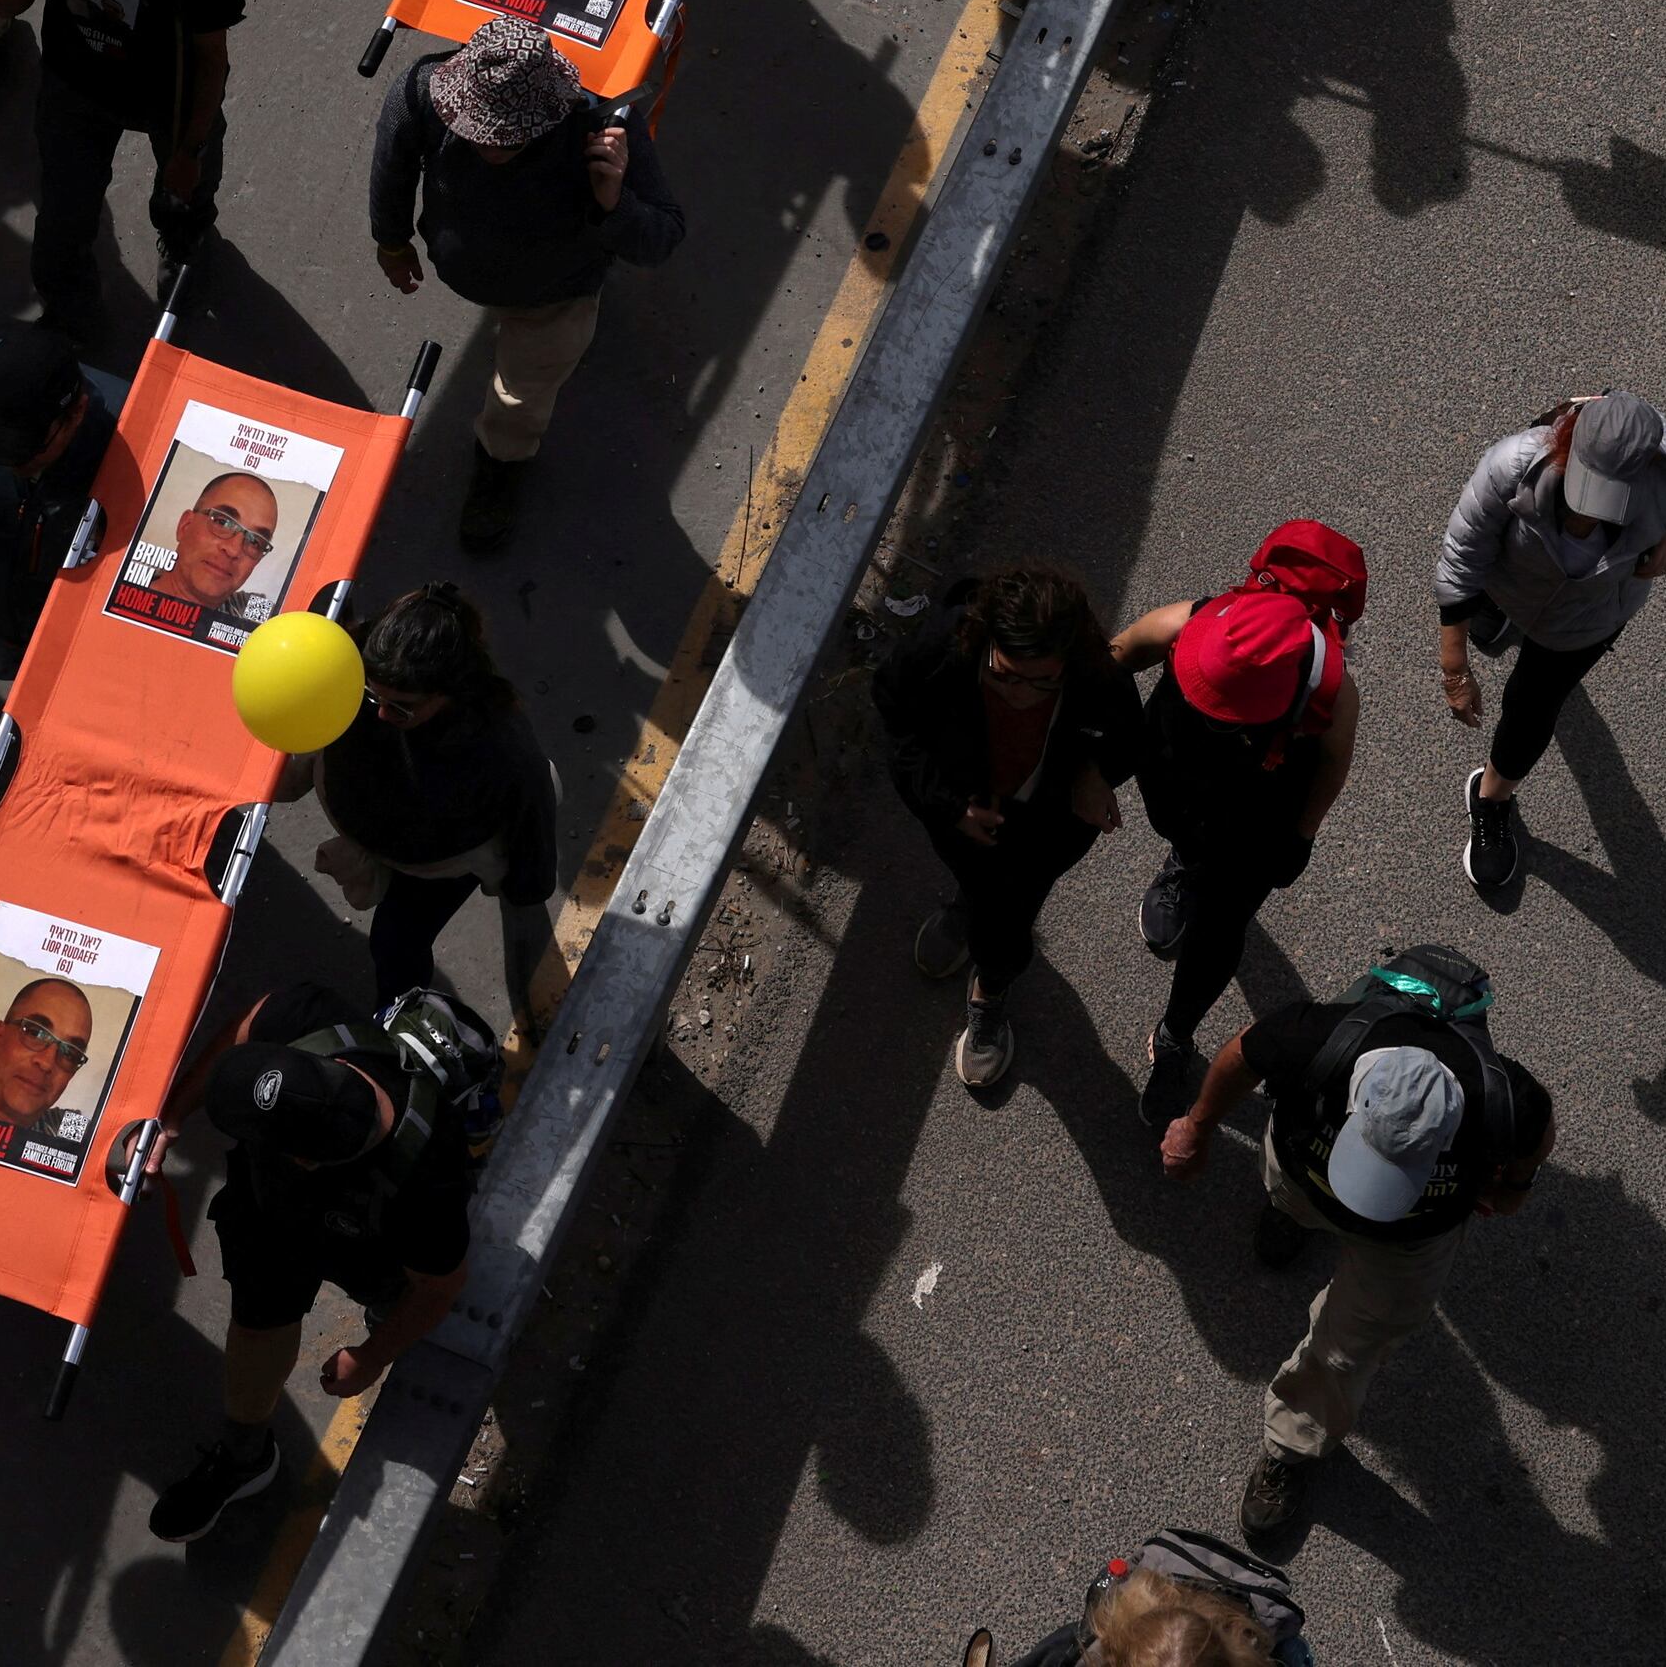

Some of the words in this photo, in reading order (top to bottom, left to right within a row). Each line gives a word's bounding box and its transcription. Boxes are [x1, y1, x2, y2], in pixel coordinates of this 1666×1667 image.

[230, 436, 249, 450] LIOR
[250, 442, 286, 461] RUDAEFF
[264, 431, 288, 449] ליאור
[243, 455, 261, 470] (61)
[132, 541, 178, 572] BRING
[123, 562, 155, 588] HIM
[114, 584, 157, 614] HOME
[158, 596, 202, 629] NOW!
[207, 627, 238, 645] FAMILIES
[41, 938, 61, 954] LIOR
[62, 944, 98, 966] RUDAEFF
[79, 933, 102, 951] ליאור
[56, 959, 74, 974] (61)
[21, 1149, 53, 1168] FAMILIES
[50, 1156, 76, 1174] FORUM
